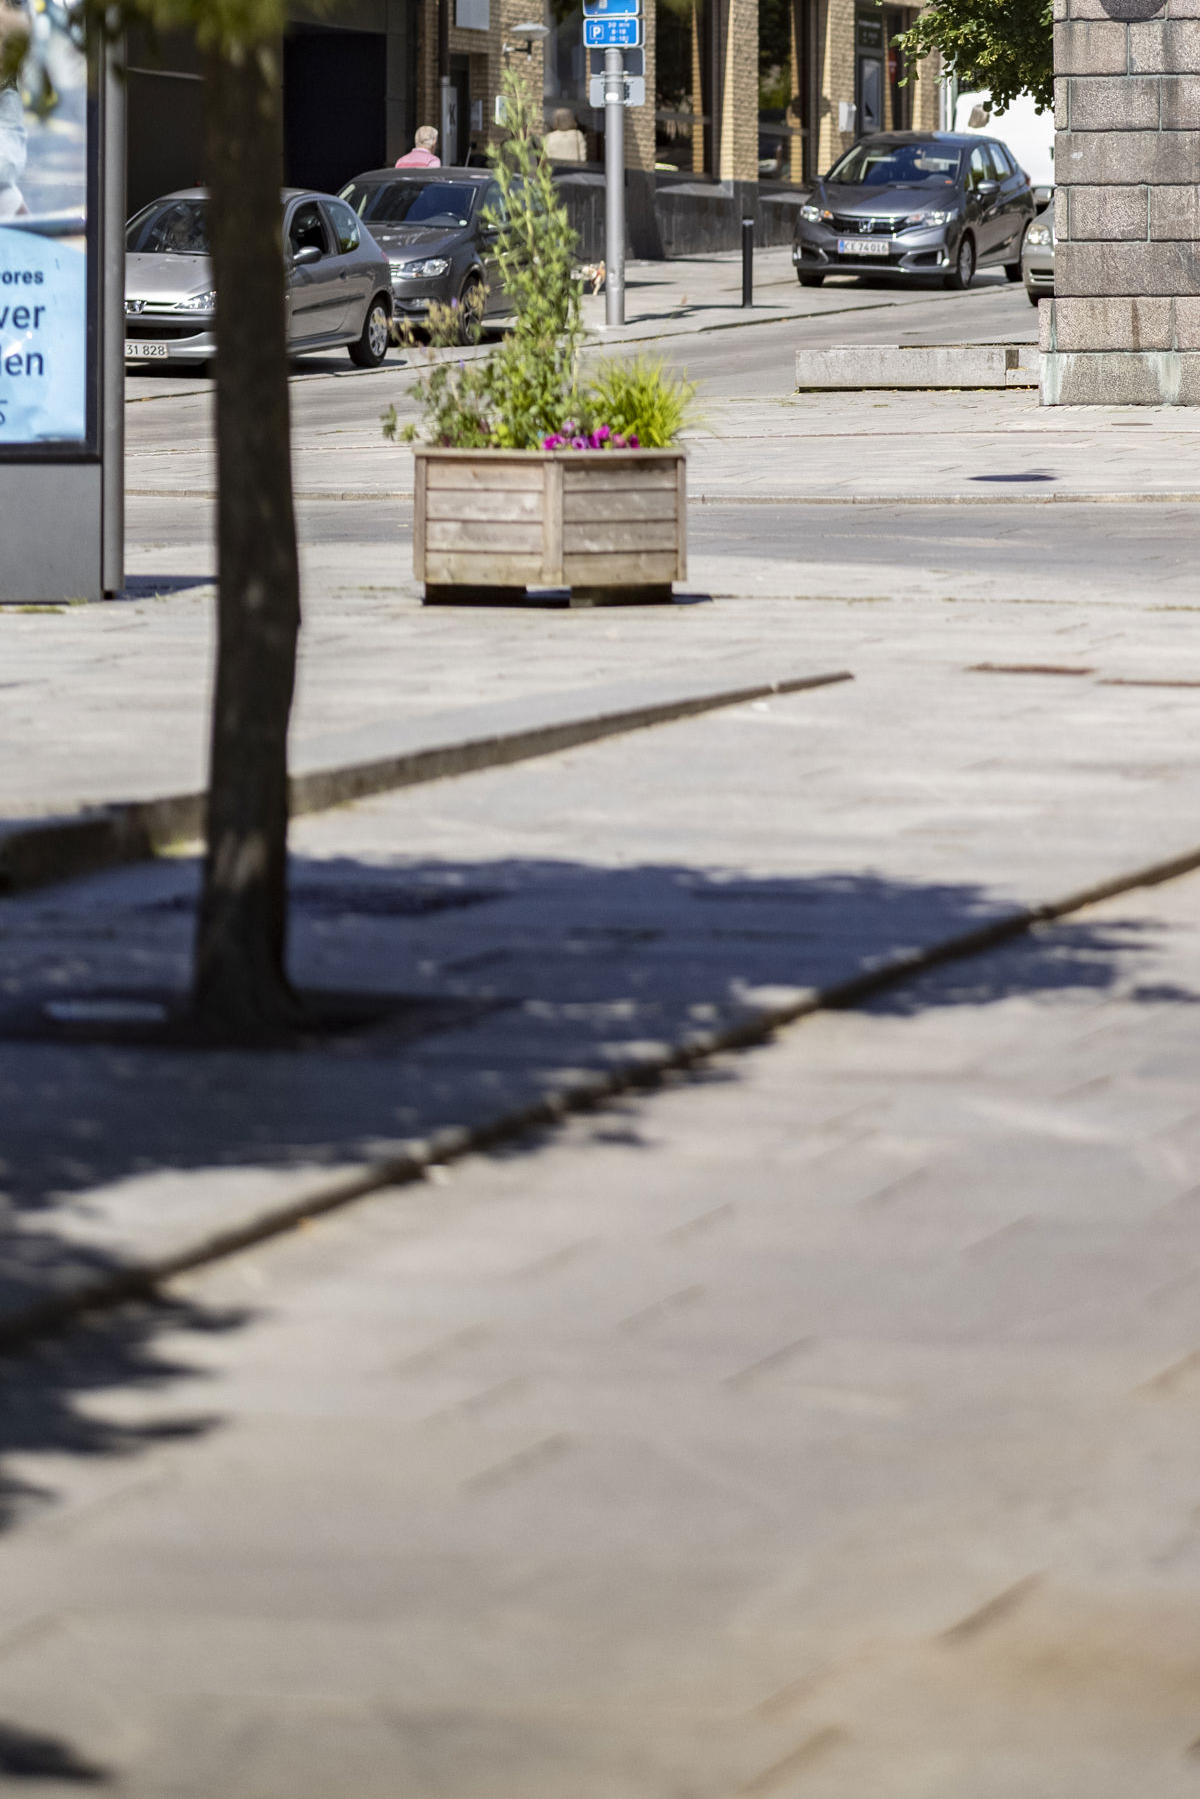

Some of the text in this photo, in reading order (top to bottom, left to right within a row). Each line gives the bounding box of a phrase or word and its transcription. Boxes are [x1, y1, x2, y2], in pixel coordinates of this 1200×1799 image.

[593, 26, 602, 38] P
[0, 271, 44, 285] ores
[126, 344, 166, 356] 31 828
[0, 344, 44, 376] en
